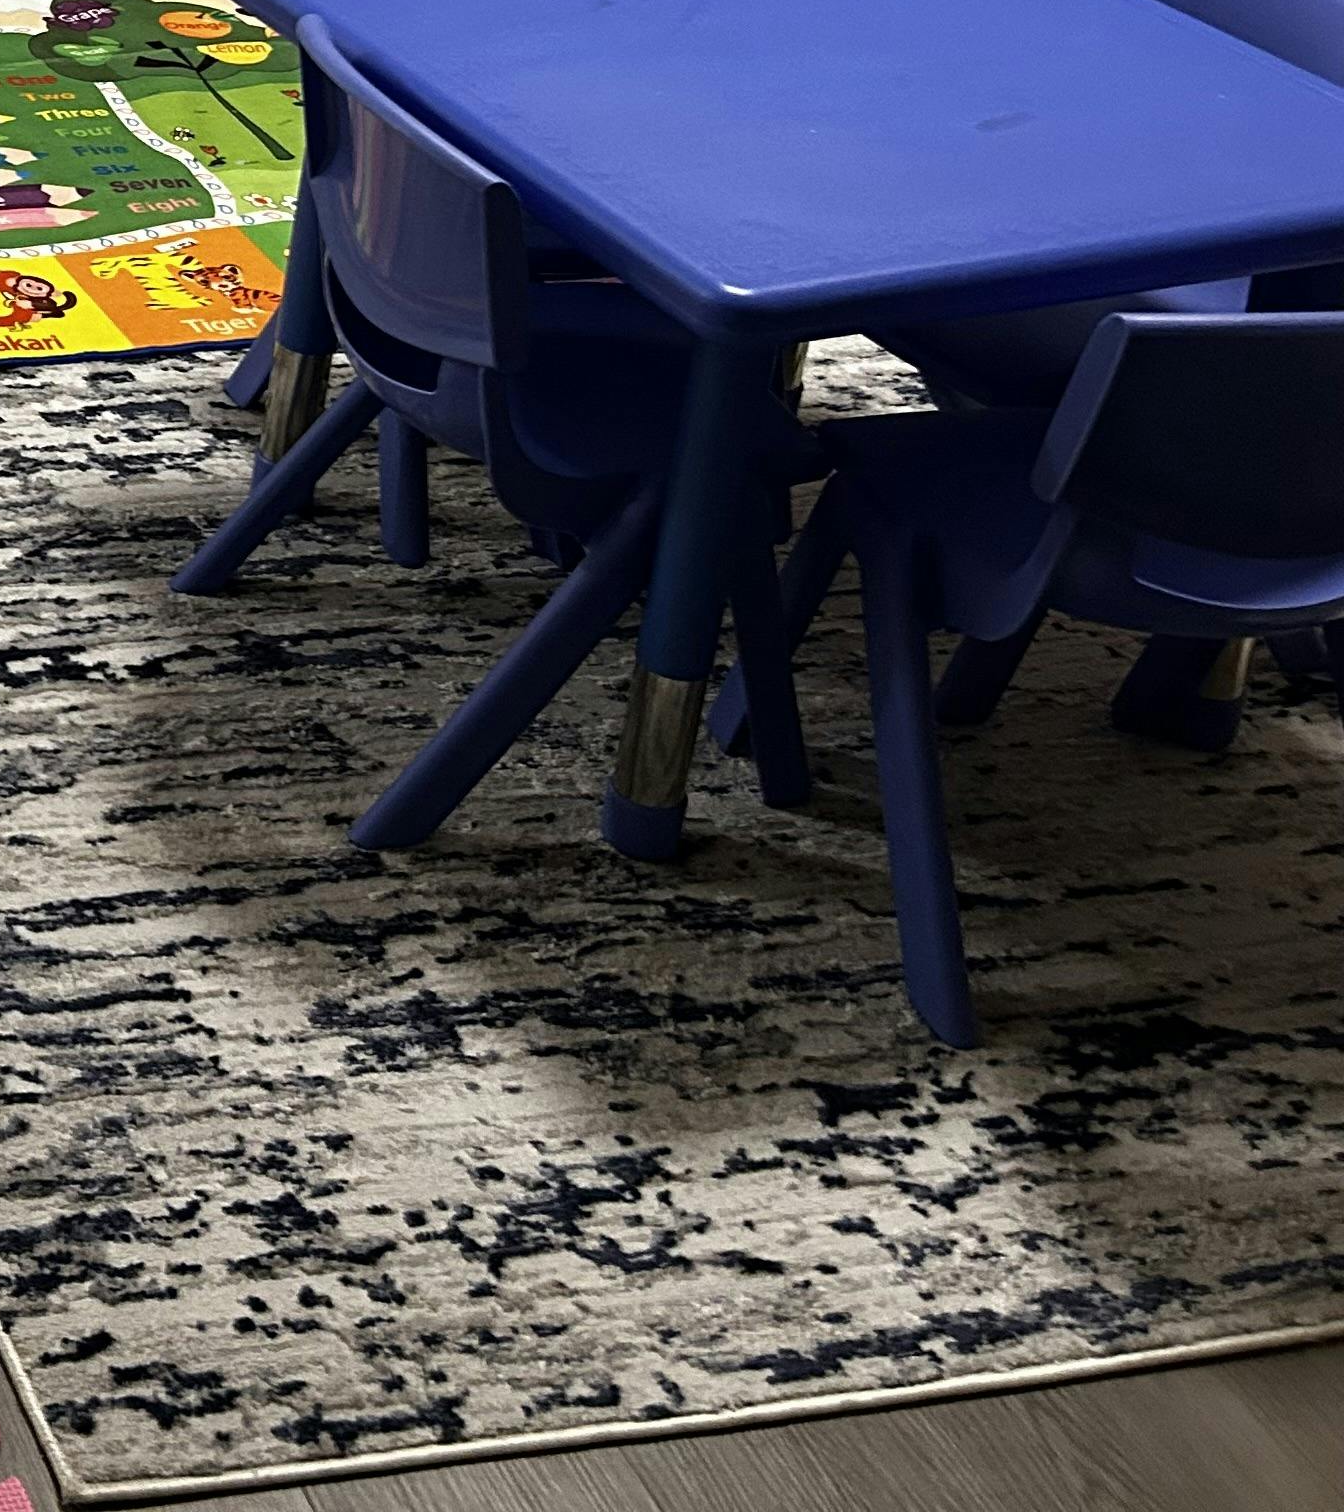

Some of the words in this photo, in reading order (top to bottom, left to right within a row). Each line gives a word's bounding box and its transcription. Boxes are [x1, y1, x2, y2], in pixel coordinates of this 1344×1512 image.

[57, 5, 114, 24] Grape
[164, 20, 230, 31] Orange
[207, 42, 267, 54] Lemon
[5, 75, 58, 85] One
[19, 91, 76, 102] Two
[34, 108, 110, 121] Three
[54, 126, 113, 138] Four
[72, 144, 129, 157] Five
[92, 163, 140, 175] Six
[110, 178, 192, 194] Seven
[127, 196, 201, 214] Eight
[88, 251, 214, 311] T
[179, 317, 258, 335] Tiger
